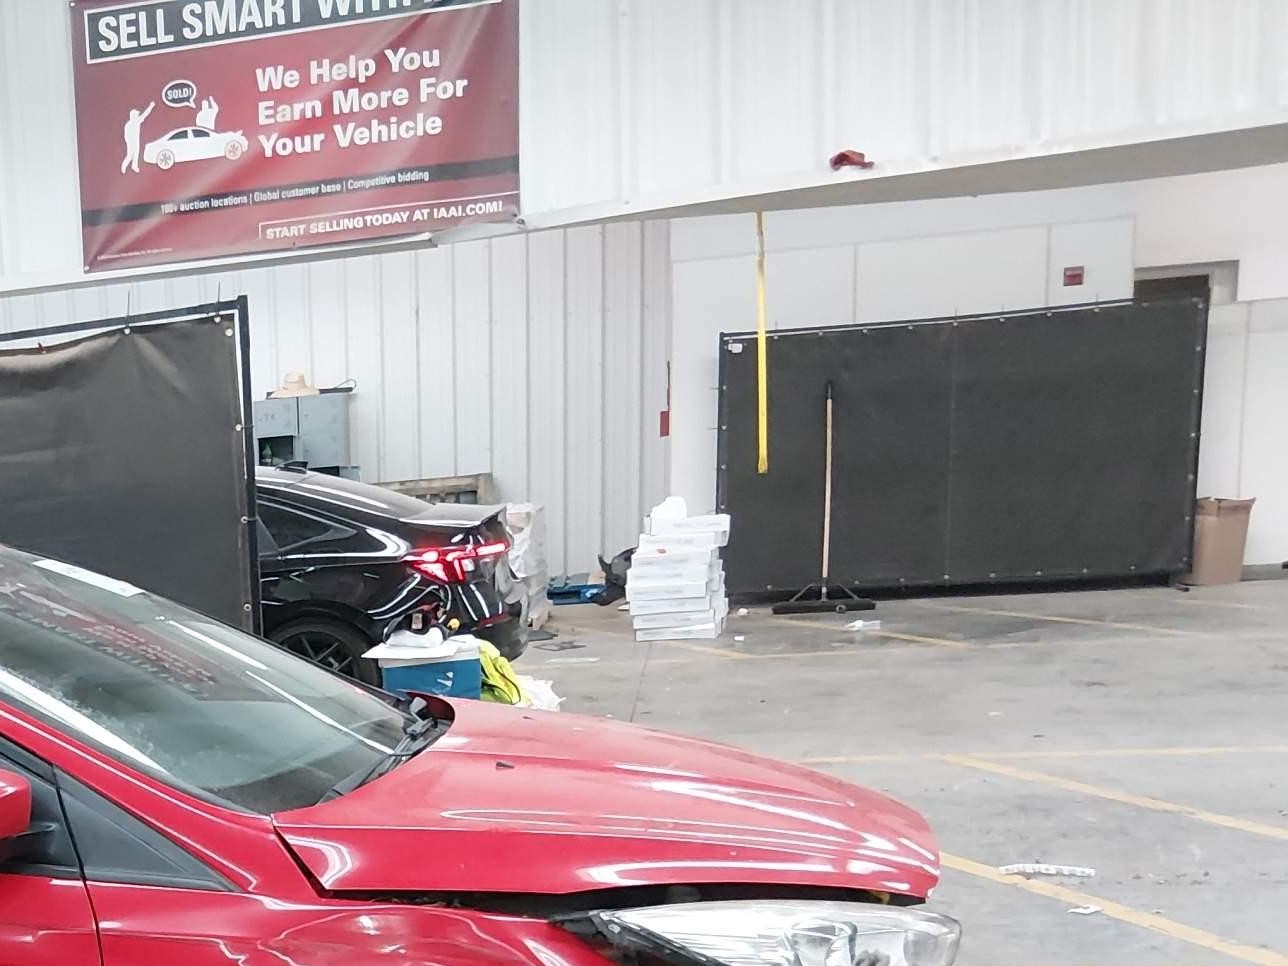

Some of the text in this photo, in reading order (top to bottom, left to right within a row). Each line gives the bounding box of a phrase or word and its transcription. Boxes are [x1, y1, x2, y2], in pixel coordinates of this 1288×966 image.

[98, 9, 174, 51] SELL
[255, 47, 440, 92] We Help You
[167, 87, 192, 99] SOLD!
[258, 77, 468, 125] Earn More For
[258, 112, 442, 158] Your Vehicle
[180, 199, 210, 211] auction
[211, 194, 248, 208] locations
[254, 188, 280, 202] Global
[281, 185, 320, 198] customer
[321, 183, 342, 193] base
[347, 174, 396, 190] Competitive
[397, 170, 429, 183] bidding
[266, 200, 503, 240] START SELLING TODAY AT IAAI.COM!
